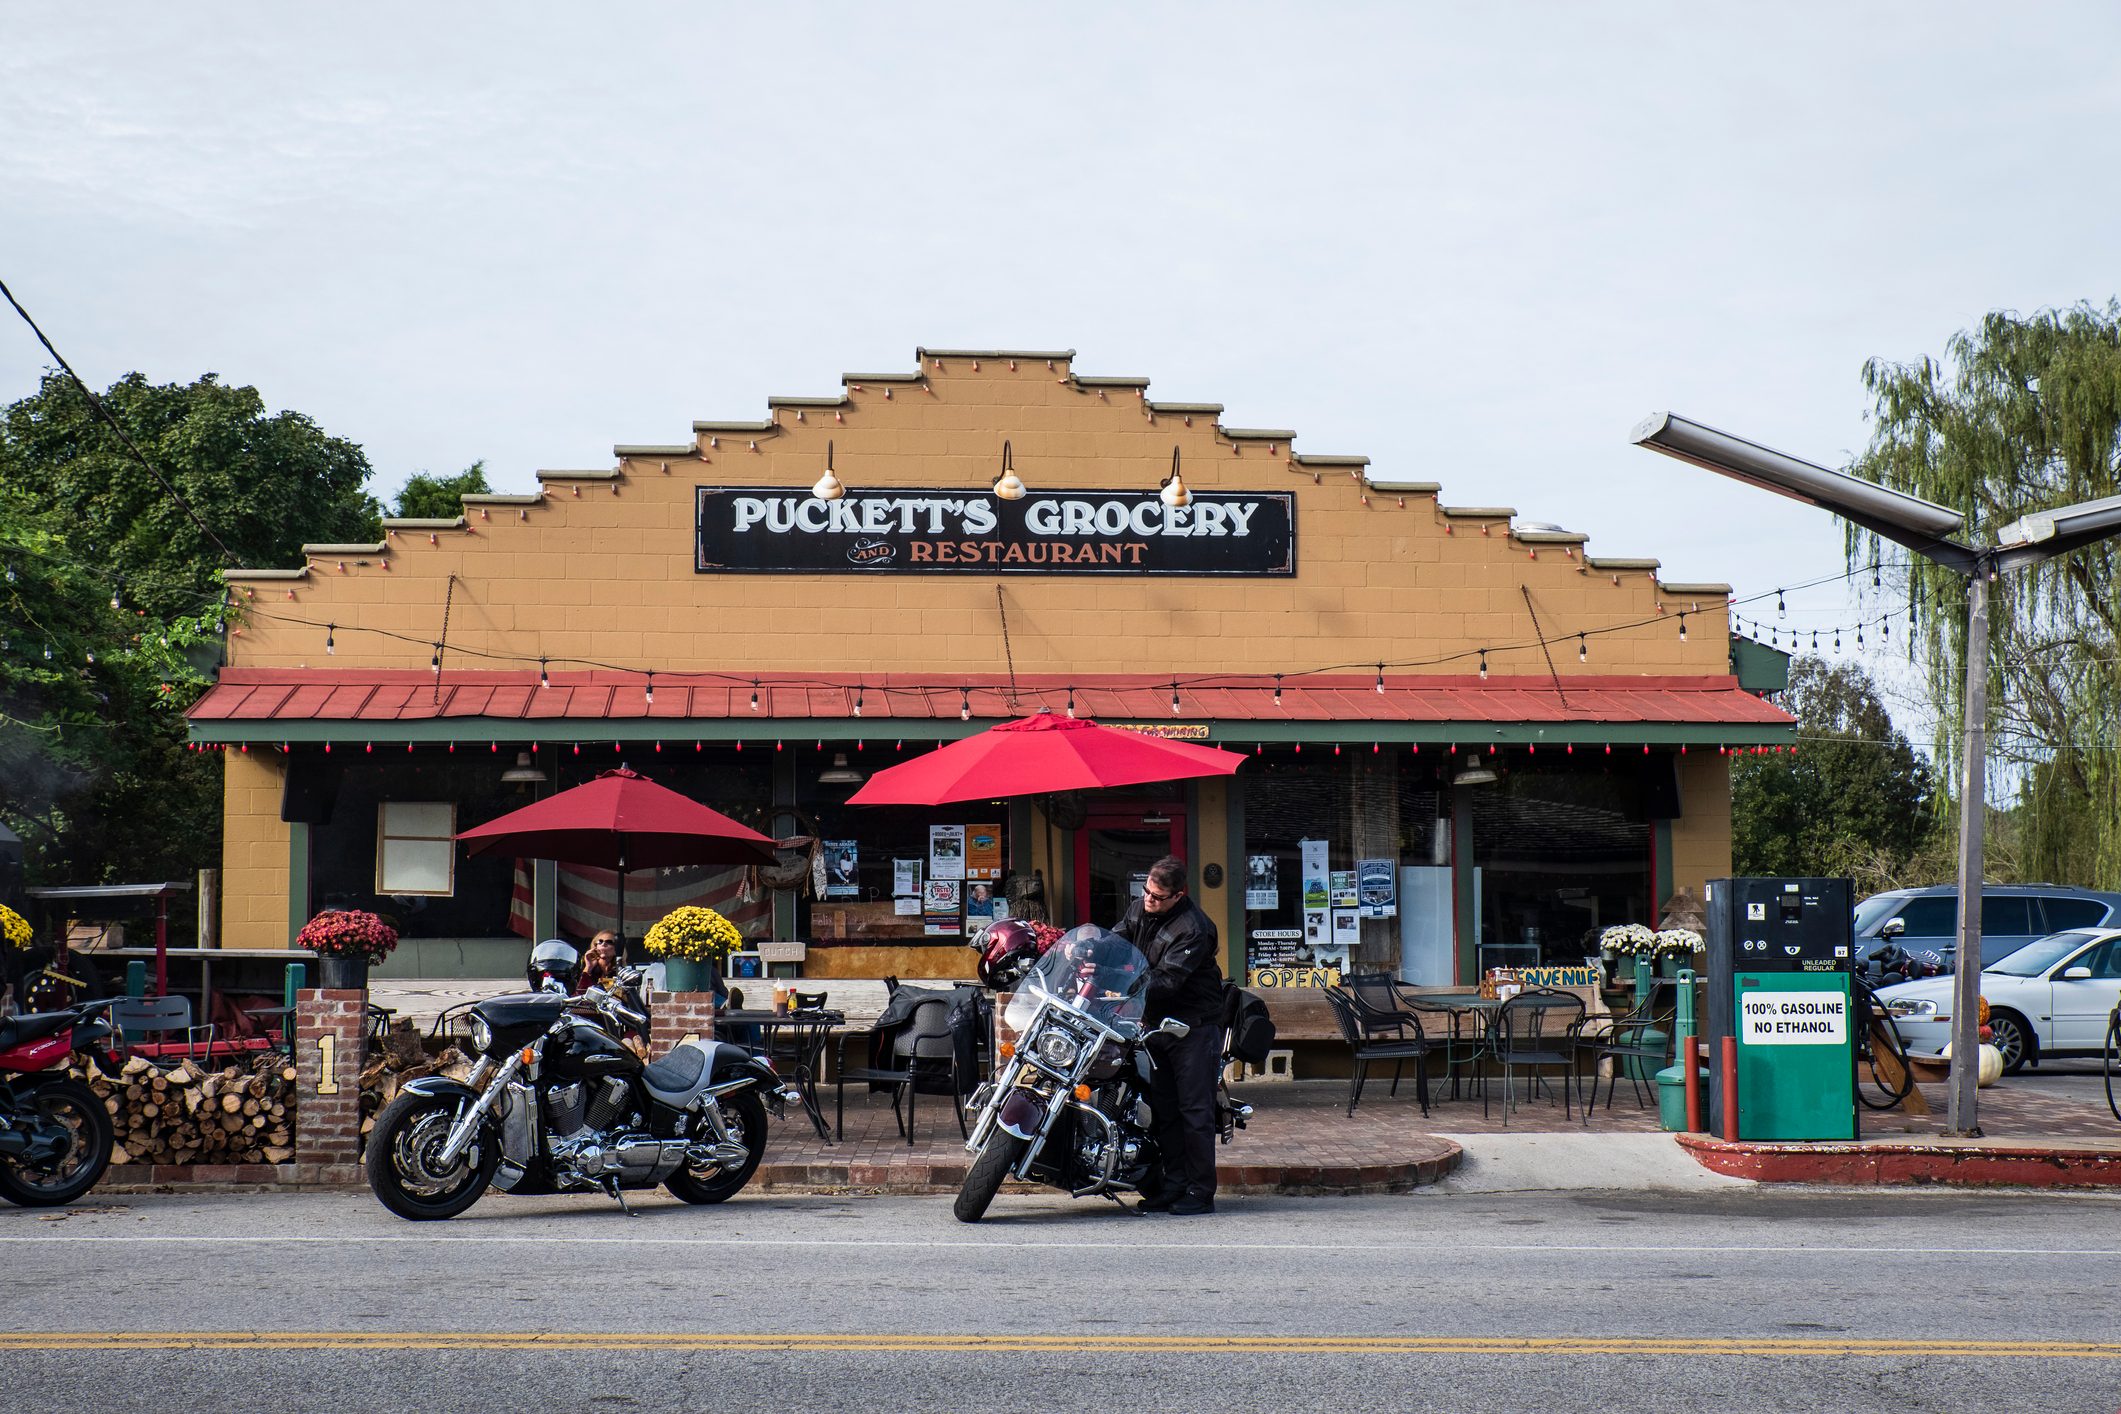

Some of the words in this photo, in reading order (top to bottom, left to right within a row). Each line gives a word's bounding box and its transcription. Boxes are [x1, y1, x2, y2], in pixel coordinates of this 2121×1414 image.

[732, 497, 998, 535] PUCKETT'S
[1025, 499, 1259, 538] GROCERY
[855, 546, 890, 560] AND
[910, 541, 1148, 564] RESTAURANT
[1257, 969, 1329, 988] OPEN
[1744, 1003, 1777, 1015] 100%
[1781, 1003, 1843, 1015] GASOLINE
[1754, 1022, 1772, 1033] NO
[1776, 1022, 1835, 1033] ETHANOL
[316, 1033, 339, 1096] 1
